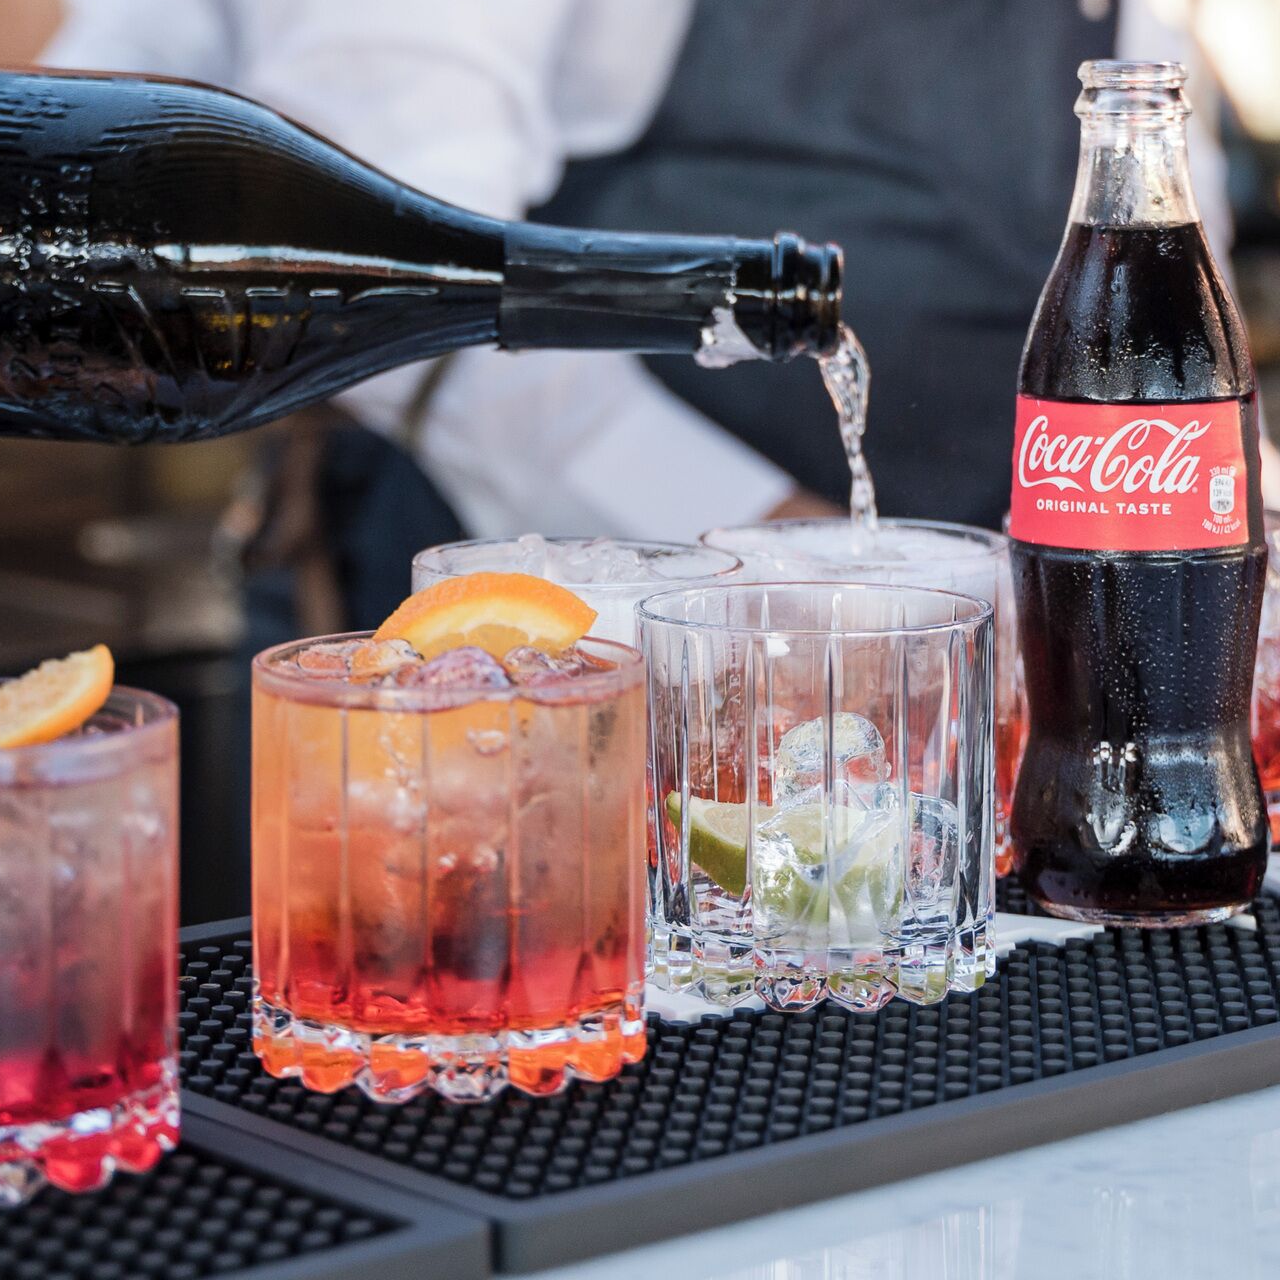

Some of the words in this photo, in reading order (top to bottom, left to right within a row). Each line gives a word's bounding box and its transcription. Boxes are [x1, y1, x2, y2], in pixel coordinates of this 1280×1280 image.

[1018, 415, 1212, 494] Coca-Cola
[1036, 498, 1108, 515] ORIGINAL
[1116, 502, 1172, 516] TASTE
